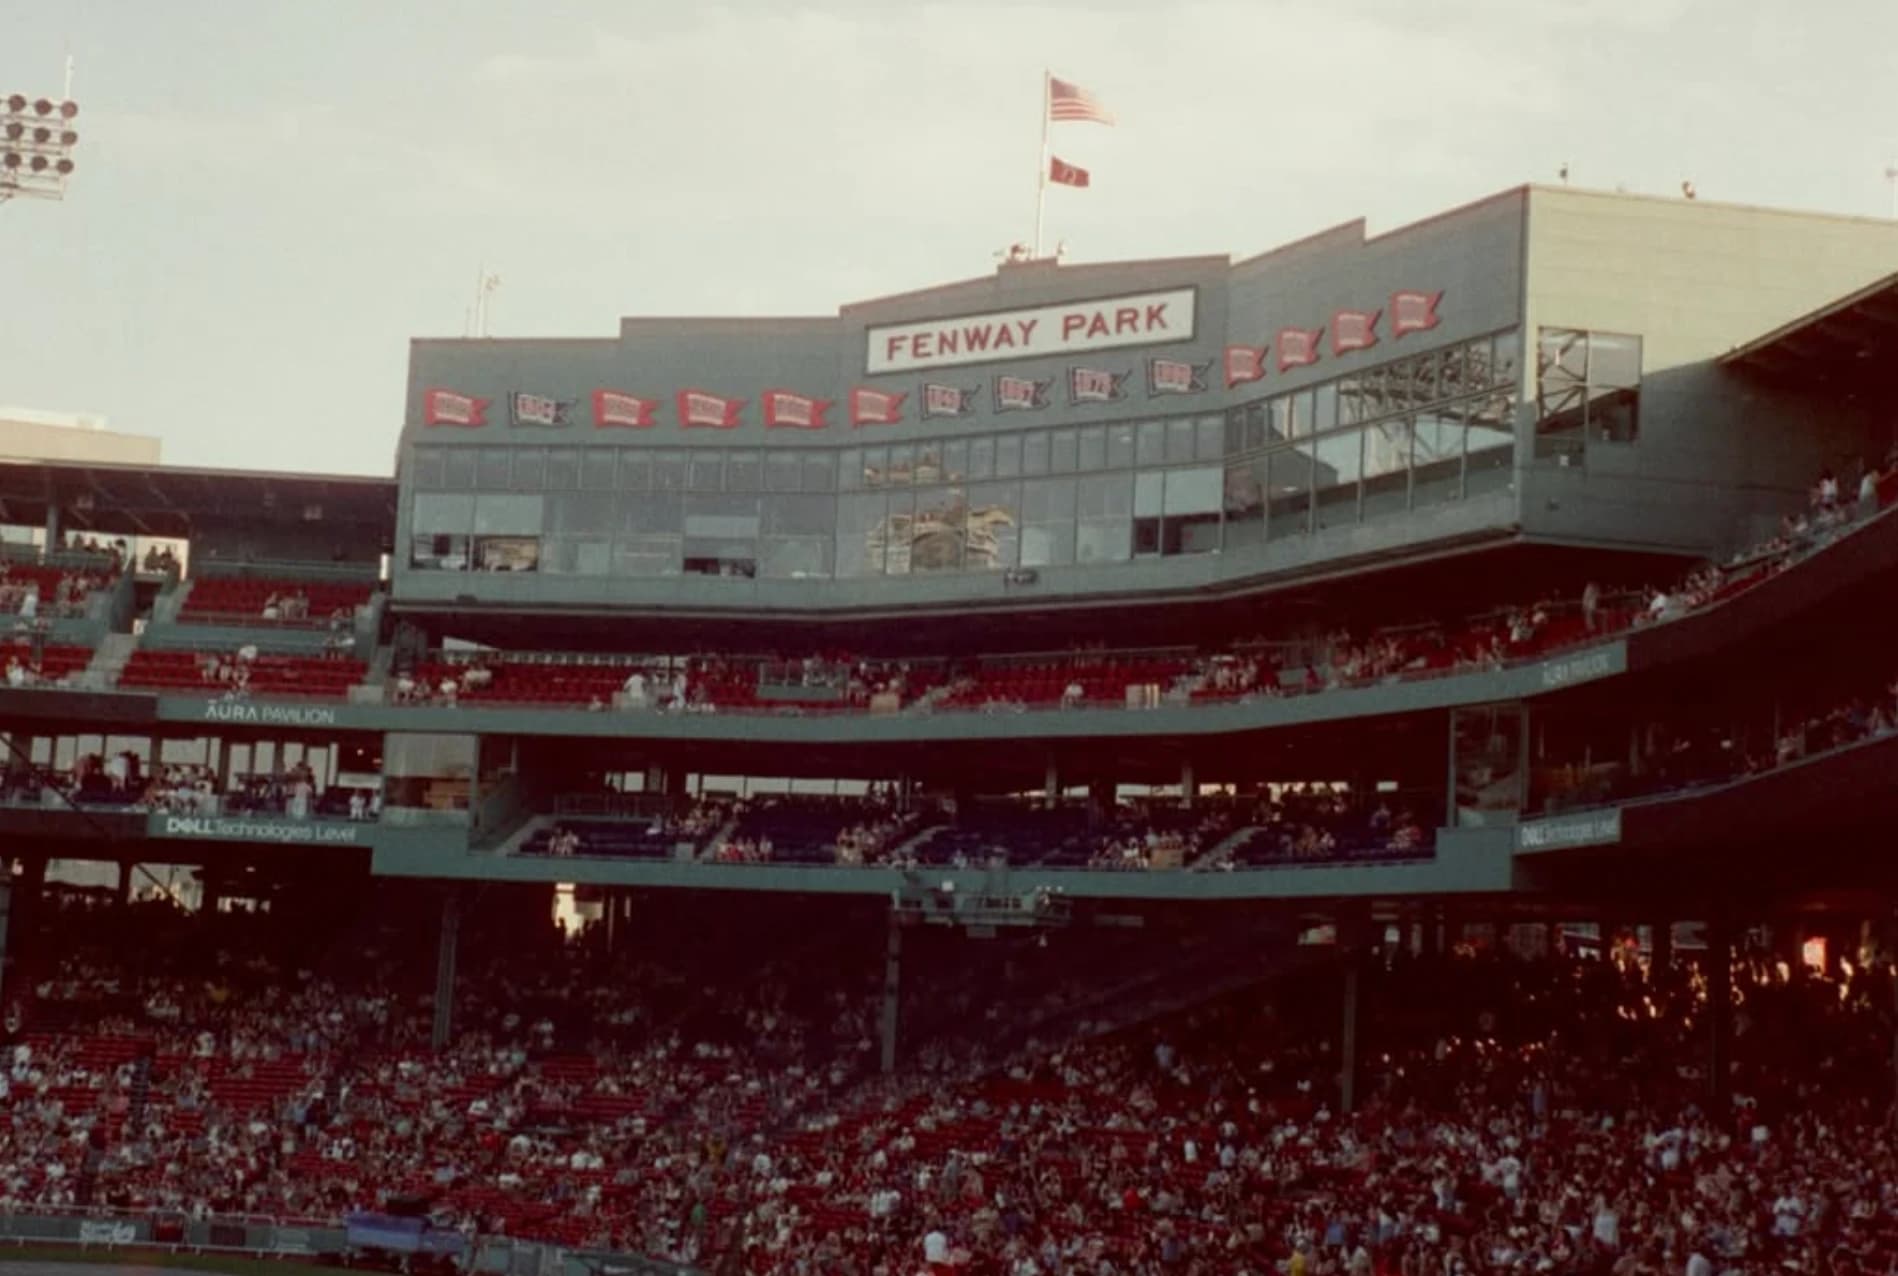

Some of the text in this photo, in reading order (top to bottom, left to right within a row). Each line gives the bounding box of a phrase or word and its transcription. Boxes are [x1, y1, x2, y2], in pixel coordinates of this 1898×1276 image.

[887, 303, 1168, 361] FENWAY PARK
[262, 706, 335, 724] PAVILION
[166, 818, 356, 841] DELL Technologies Level
